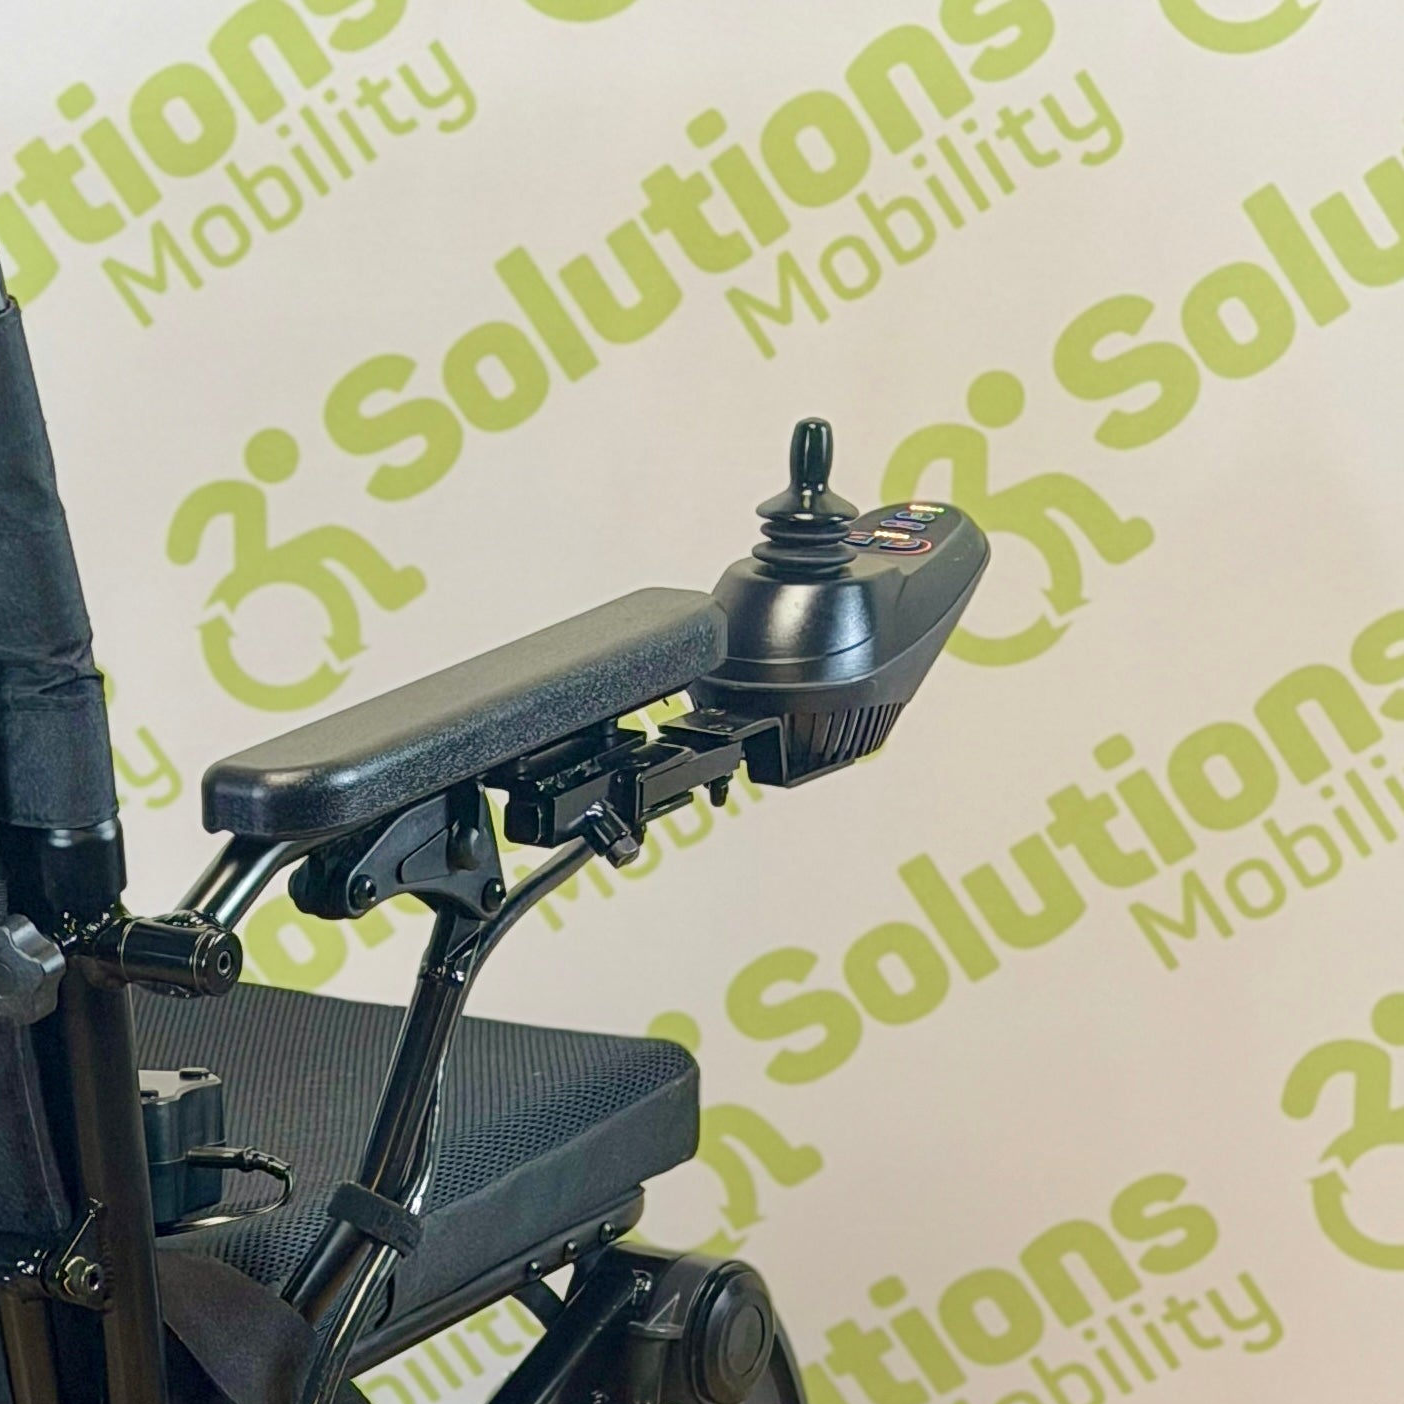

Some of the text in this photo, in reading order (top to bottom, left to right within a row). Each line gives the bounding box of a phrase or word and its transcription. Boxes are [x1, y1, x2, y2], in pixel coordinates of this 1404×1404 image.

[101, 41, 477, 328] Mobility
[322, 0, 1056, 503] Solutions
[724, 70, 1125, 360] Mobility
